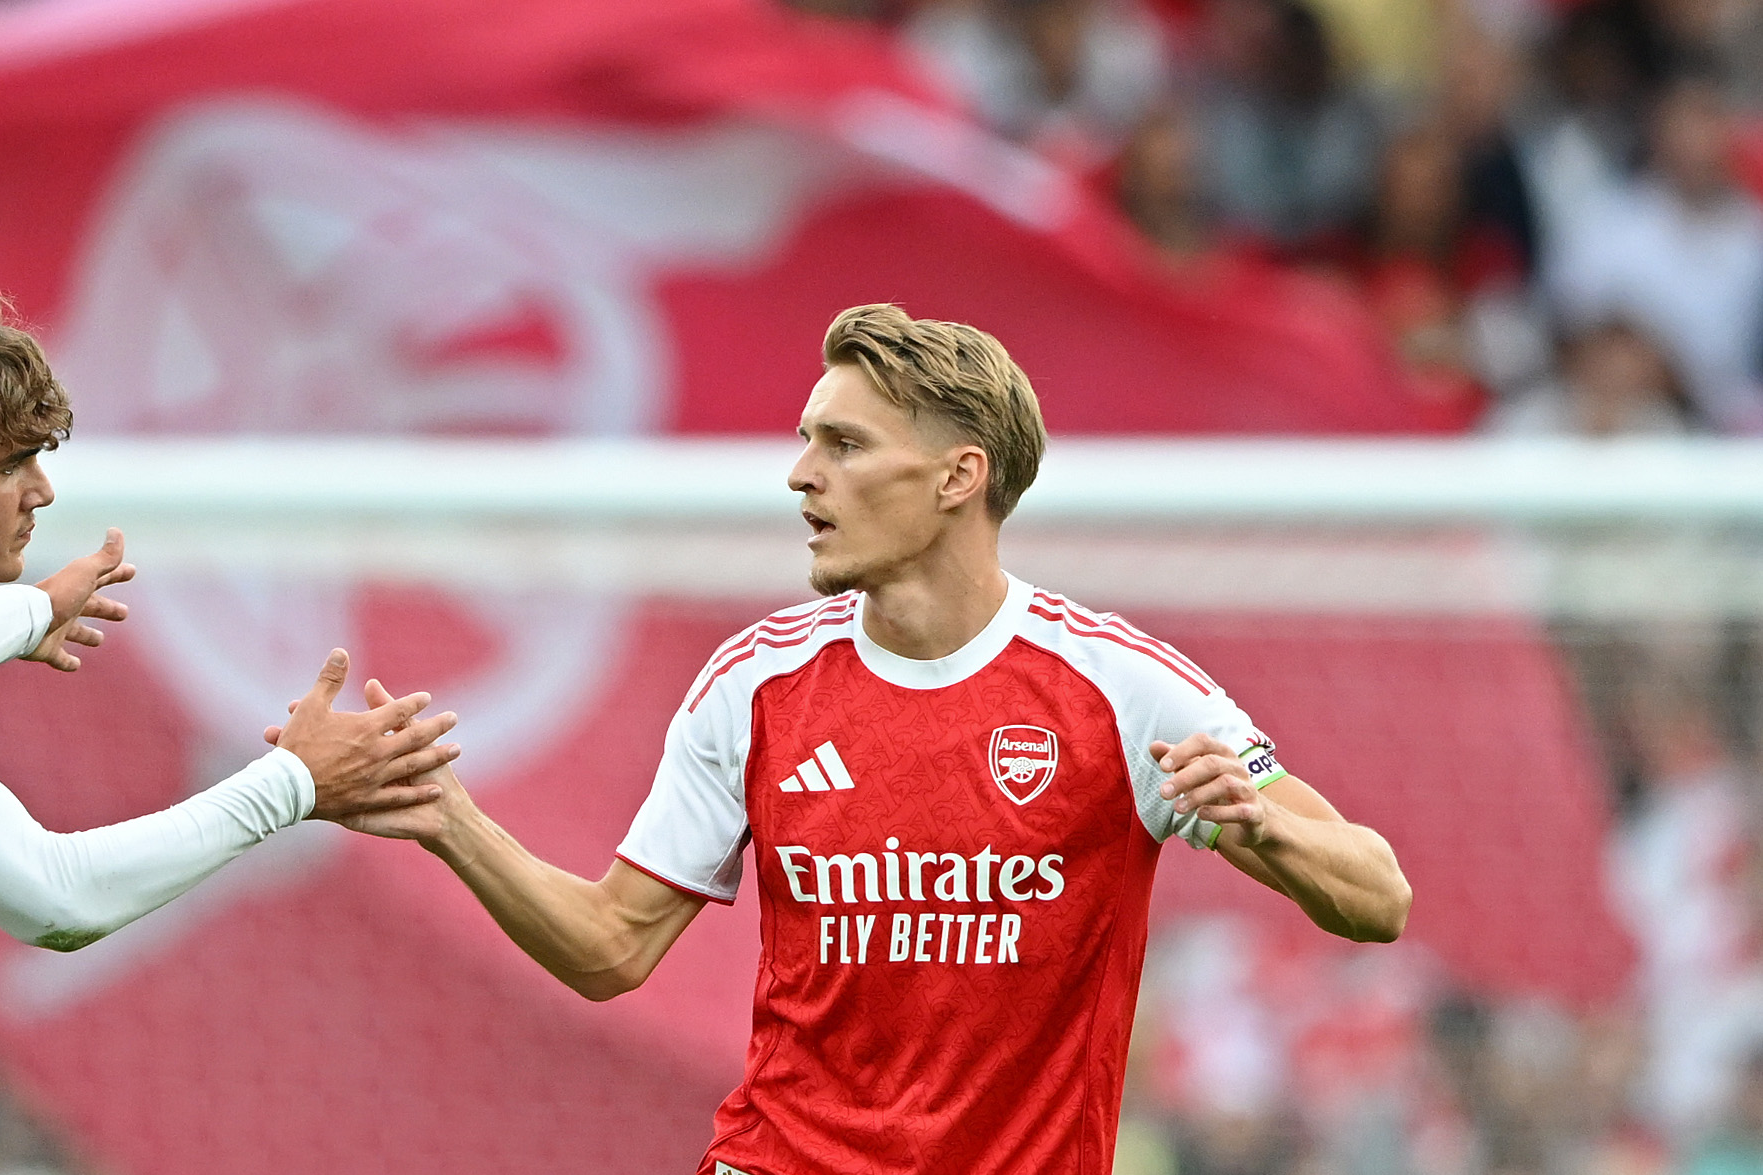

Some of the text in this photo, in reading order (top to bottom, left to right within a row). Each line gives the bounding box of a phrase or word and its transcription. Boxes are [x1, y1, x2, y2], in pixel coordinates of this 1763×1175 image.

[999, 738, 1048, 753] Arsenal
[775, 837, 1065, 904] Emirates
[820, 913, 1021, 964] FLY BETTER
